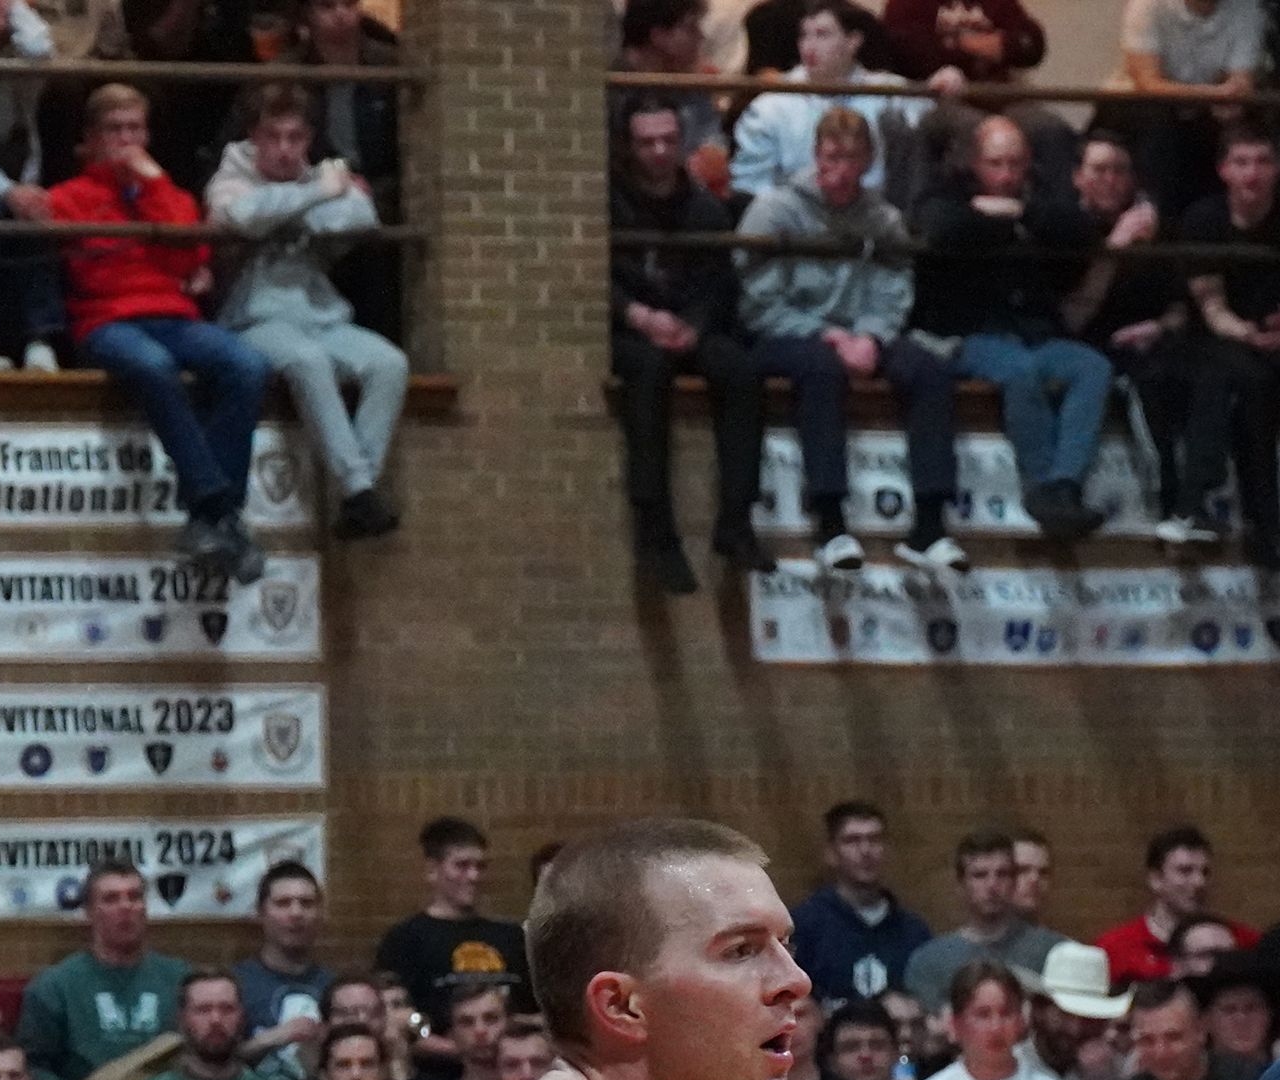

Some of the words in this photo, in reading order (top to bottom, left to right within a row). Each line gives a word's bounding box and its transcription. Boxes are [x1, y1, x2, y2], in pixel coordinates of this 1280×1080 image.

[117, 441, 153, 472] de
[152, 699, 235, 734] 2023
[156, 829, 236, 867] 2024
